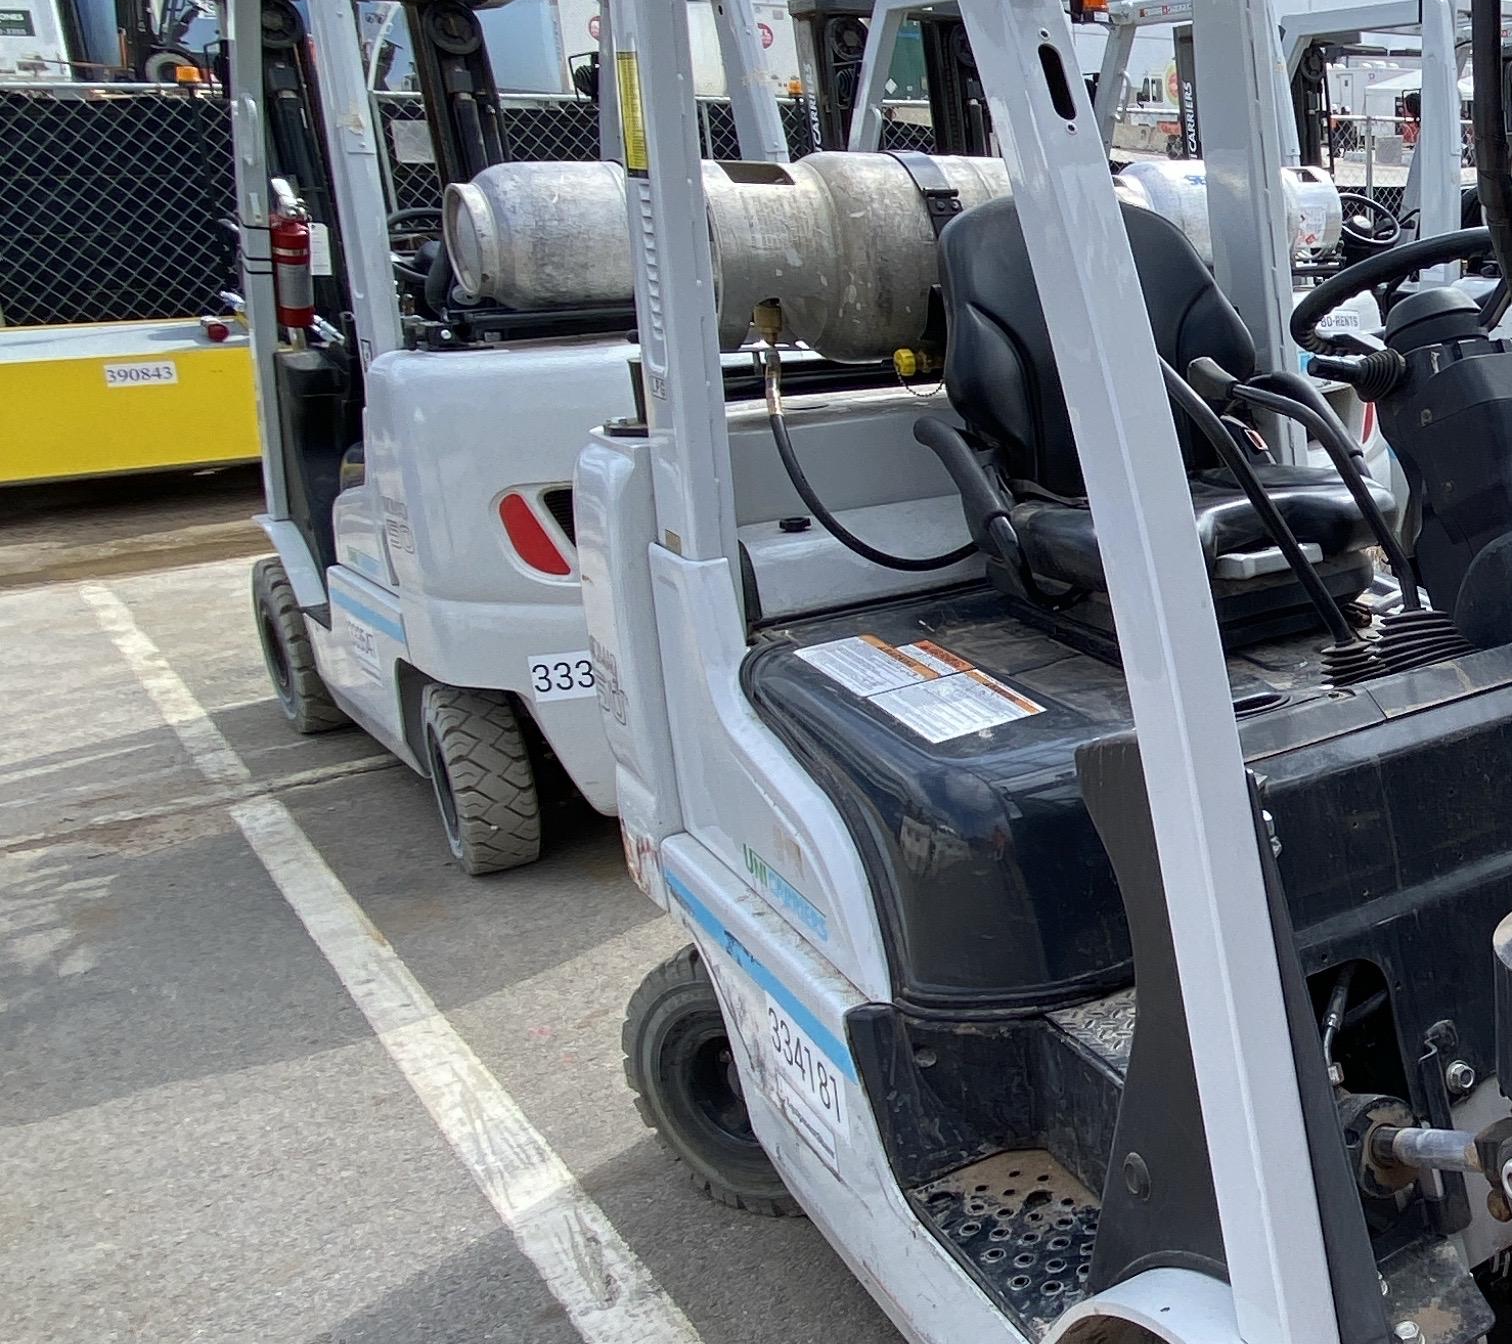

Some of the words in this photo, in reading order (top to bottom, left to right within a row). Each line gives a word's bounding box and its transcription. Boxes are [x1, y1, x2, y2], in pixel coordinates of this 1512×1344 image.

[106, 366, 173, 383] 390843
[532, 659, 596, 693] 333
[768, 1007, 841, 1124] 334181
